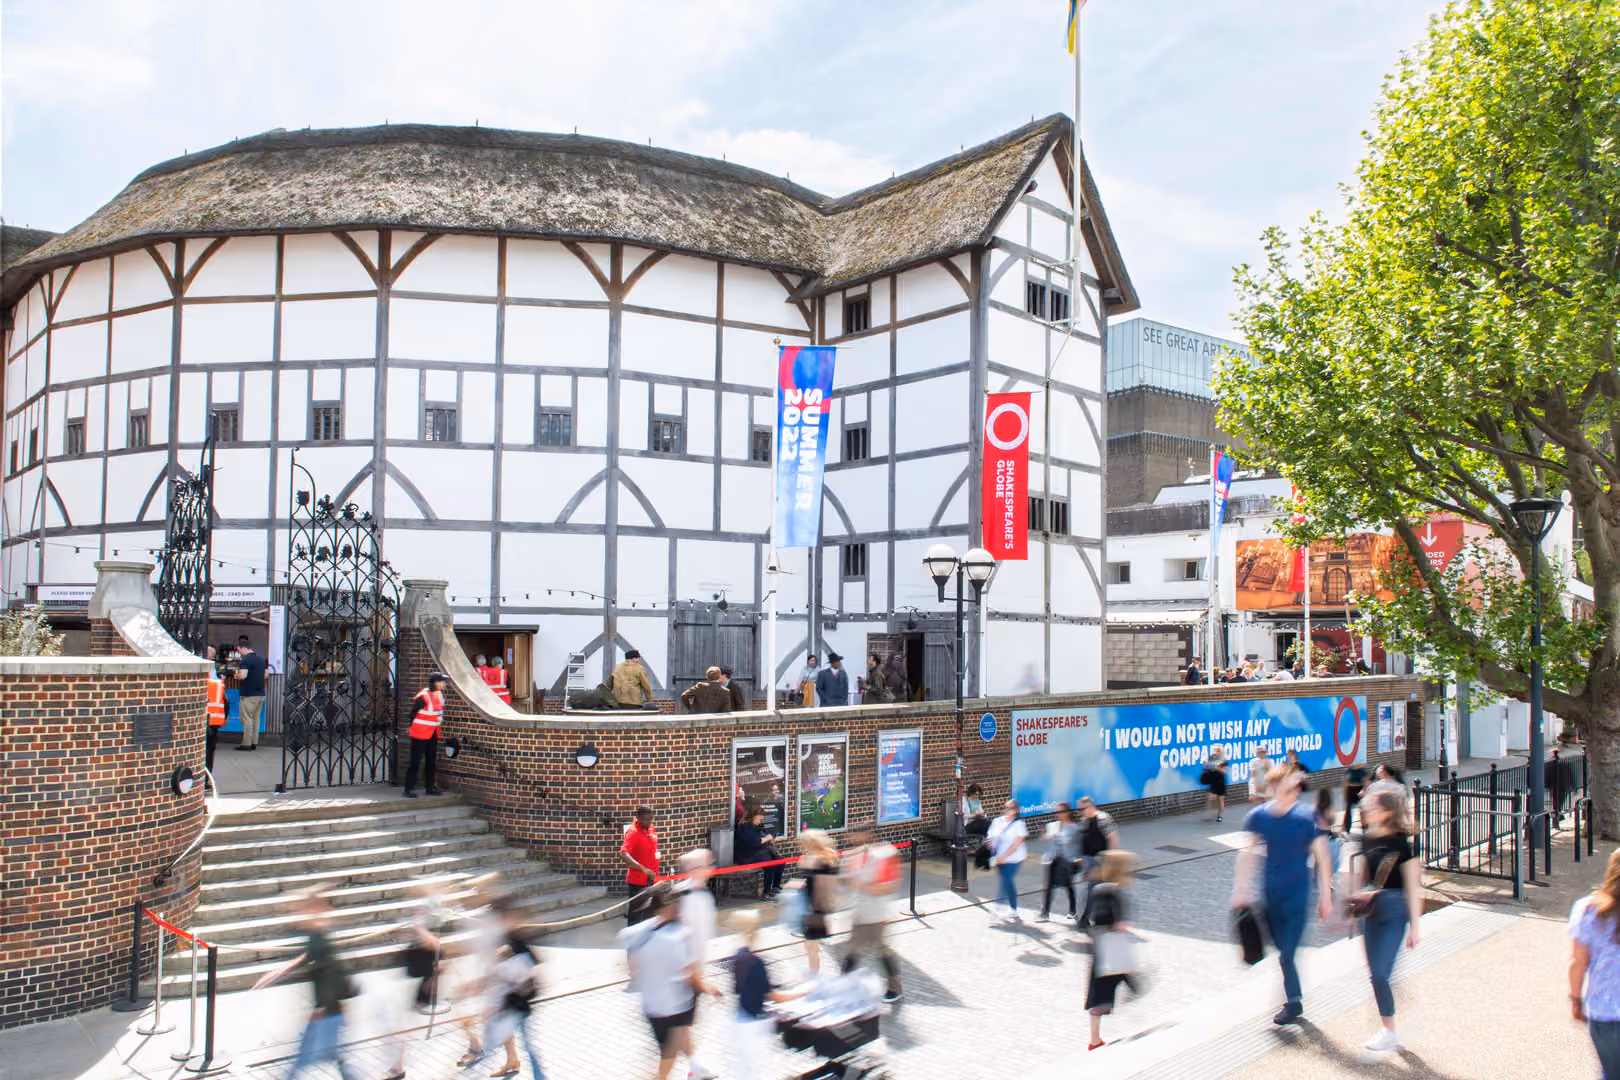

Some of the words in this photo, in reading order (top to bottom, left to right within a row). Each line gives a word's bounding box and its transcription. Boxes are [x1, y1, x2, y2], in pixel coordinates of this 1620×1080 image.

[1143, 326, 1162, 344] SEE
[1166, 333, 1199, 352] GREAT
[781, 388, 803, 461] 2022
[795, 388, 823, 510] SUMMER
[996, 459, 1005, 498] GLOBE
[1004, 459, 1015, 550] SHAKESPEARE'S
[1016, 715, 1088, 732] SHAKESPEARE'S
[1115, 725, 1172, 749] WOULD
[1176, 723, 1206, 744] NOT
[1208, 720, 1243, 741] WISH
[1245, 718, 1271, 737] ANY
[1016, 733, 1048, 747] GLOBE
[1245, 740, 1257, 758] IN
[1260, 738, 1282, 755] THE
[1285, 733, 1322, 752] WORLD
